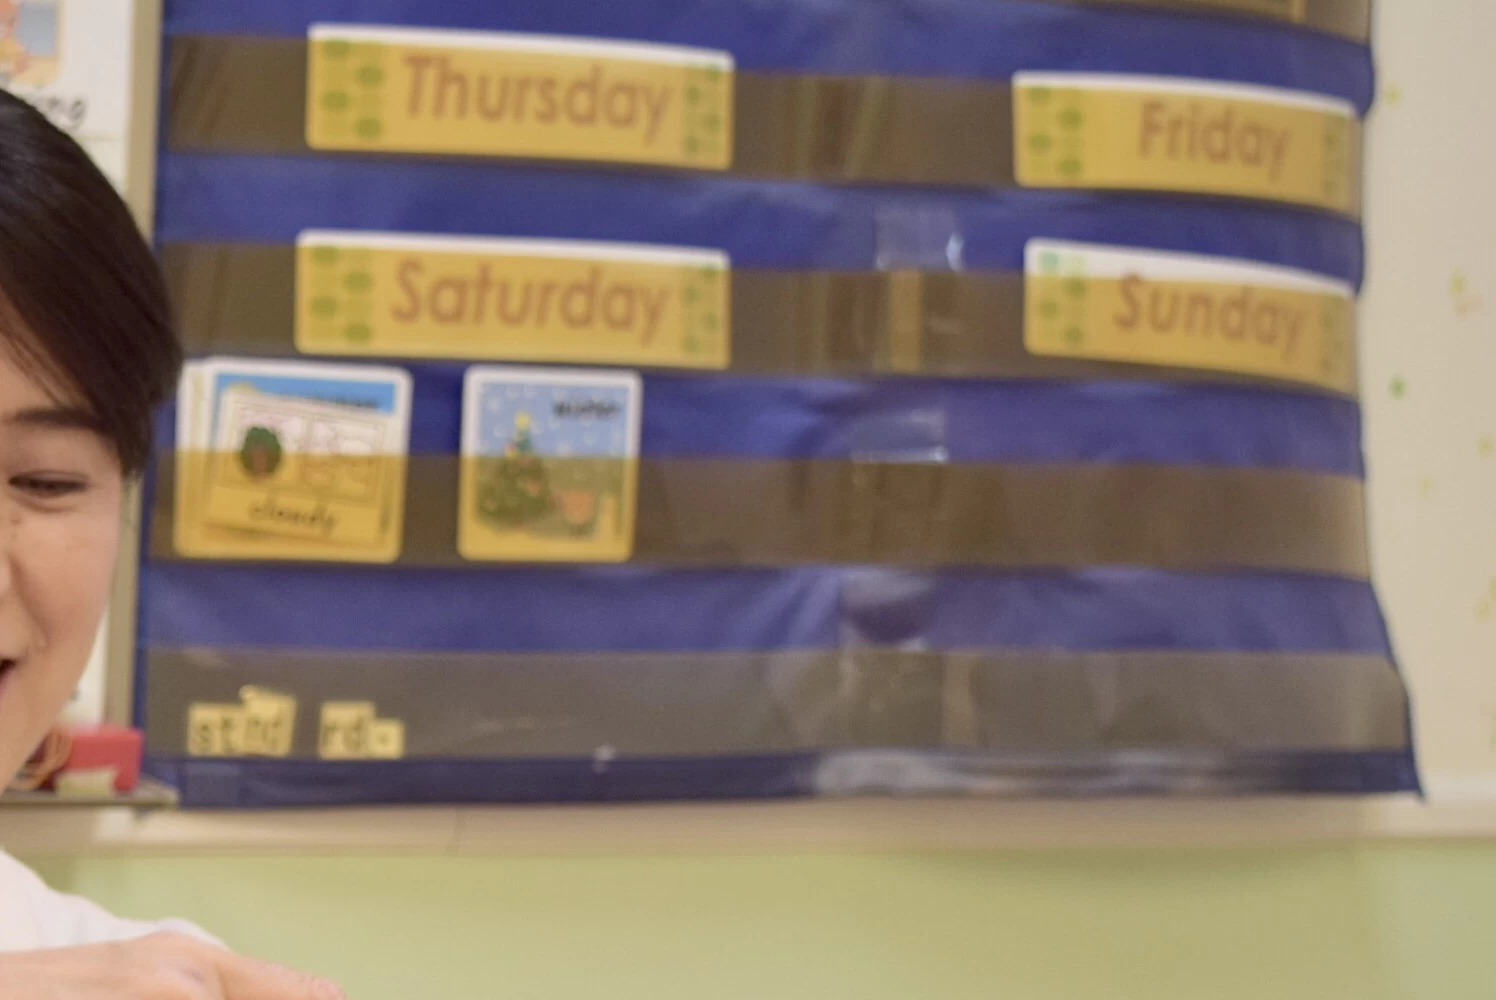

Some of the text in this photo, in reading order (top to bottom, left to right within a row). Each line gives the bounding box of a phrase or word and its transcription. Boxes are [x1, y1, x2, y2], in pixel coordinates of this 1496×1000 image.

[403, 54, 674, 147] Thursday
[1138, 97, 1291, 184] Friday
[391, 256, 668, 347] Saturday
[1112, 269, 1305, 364] Sunday
